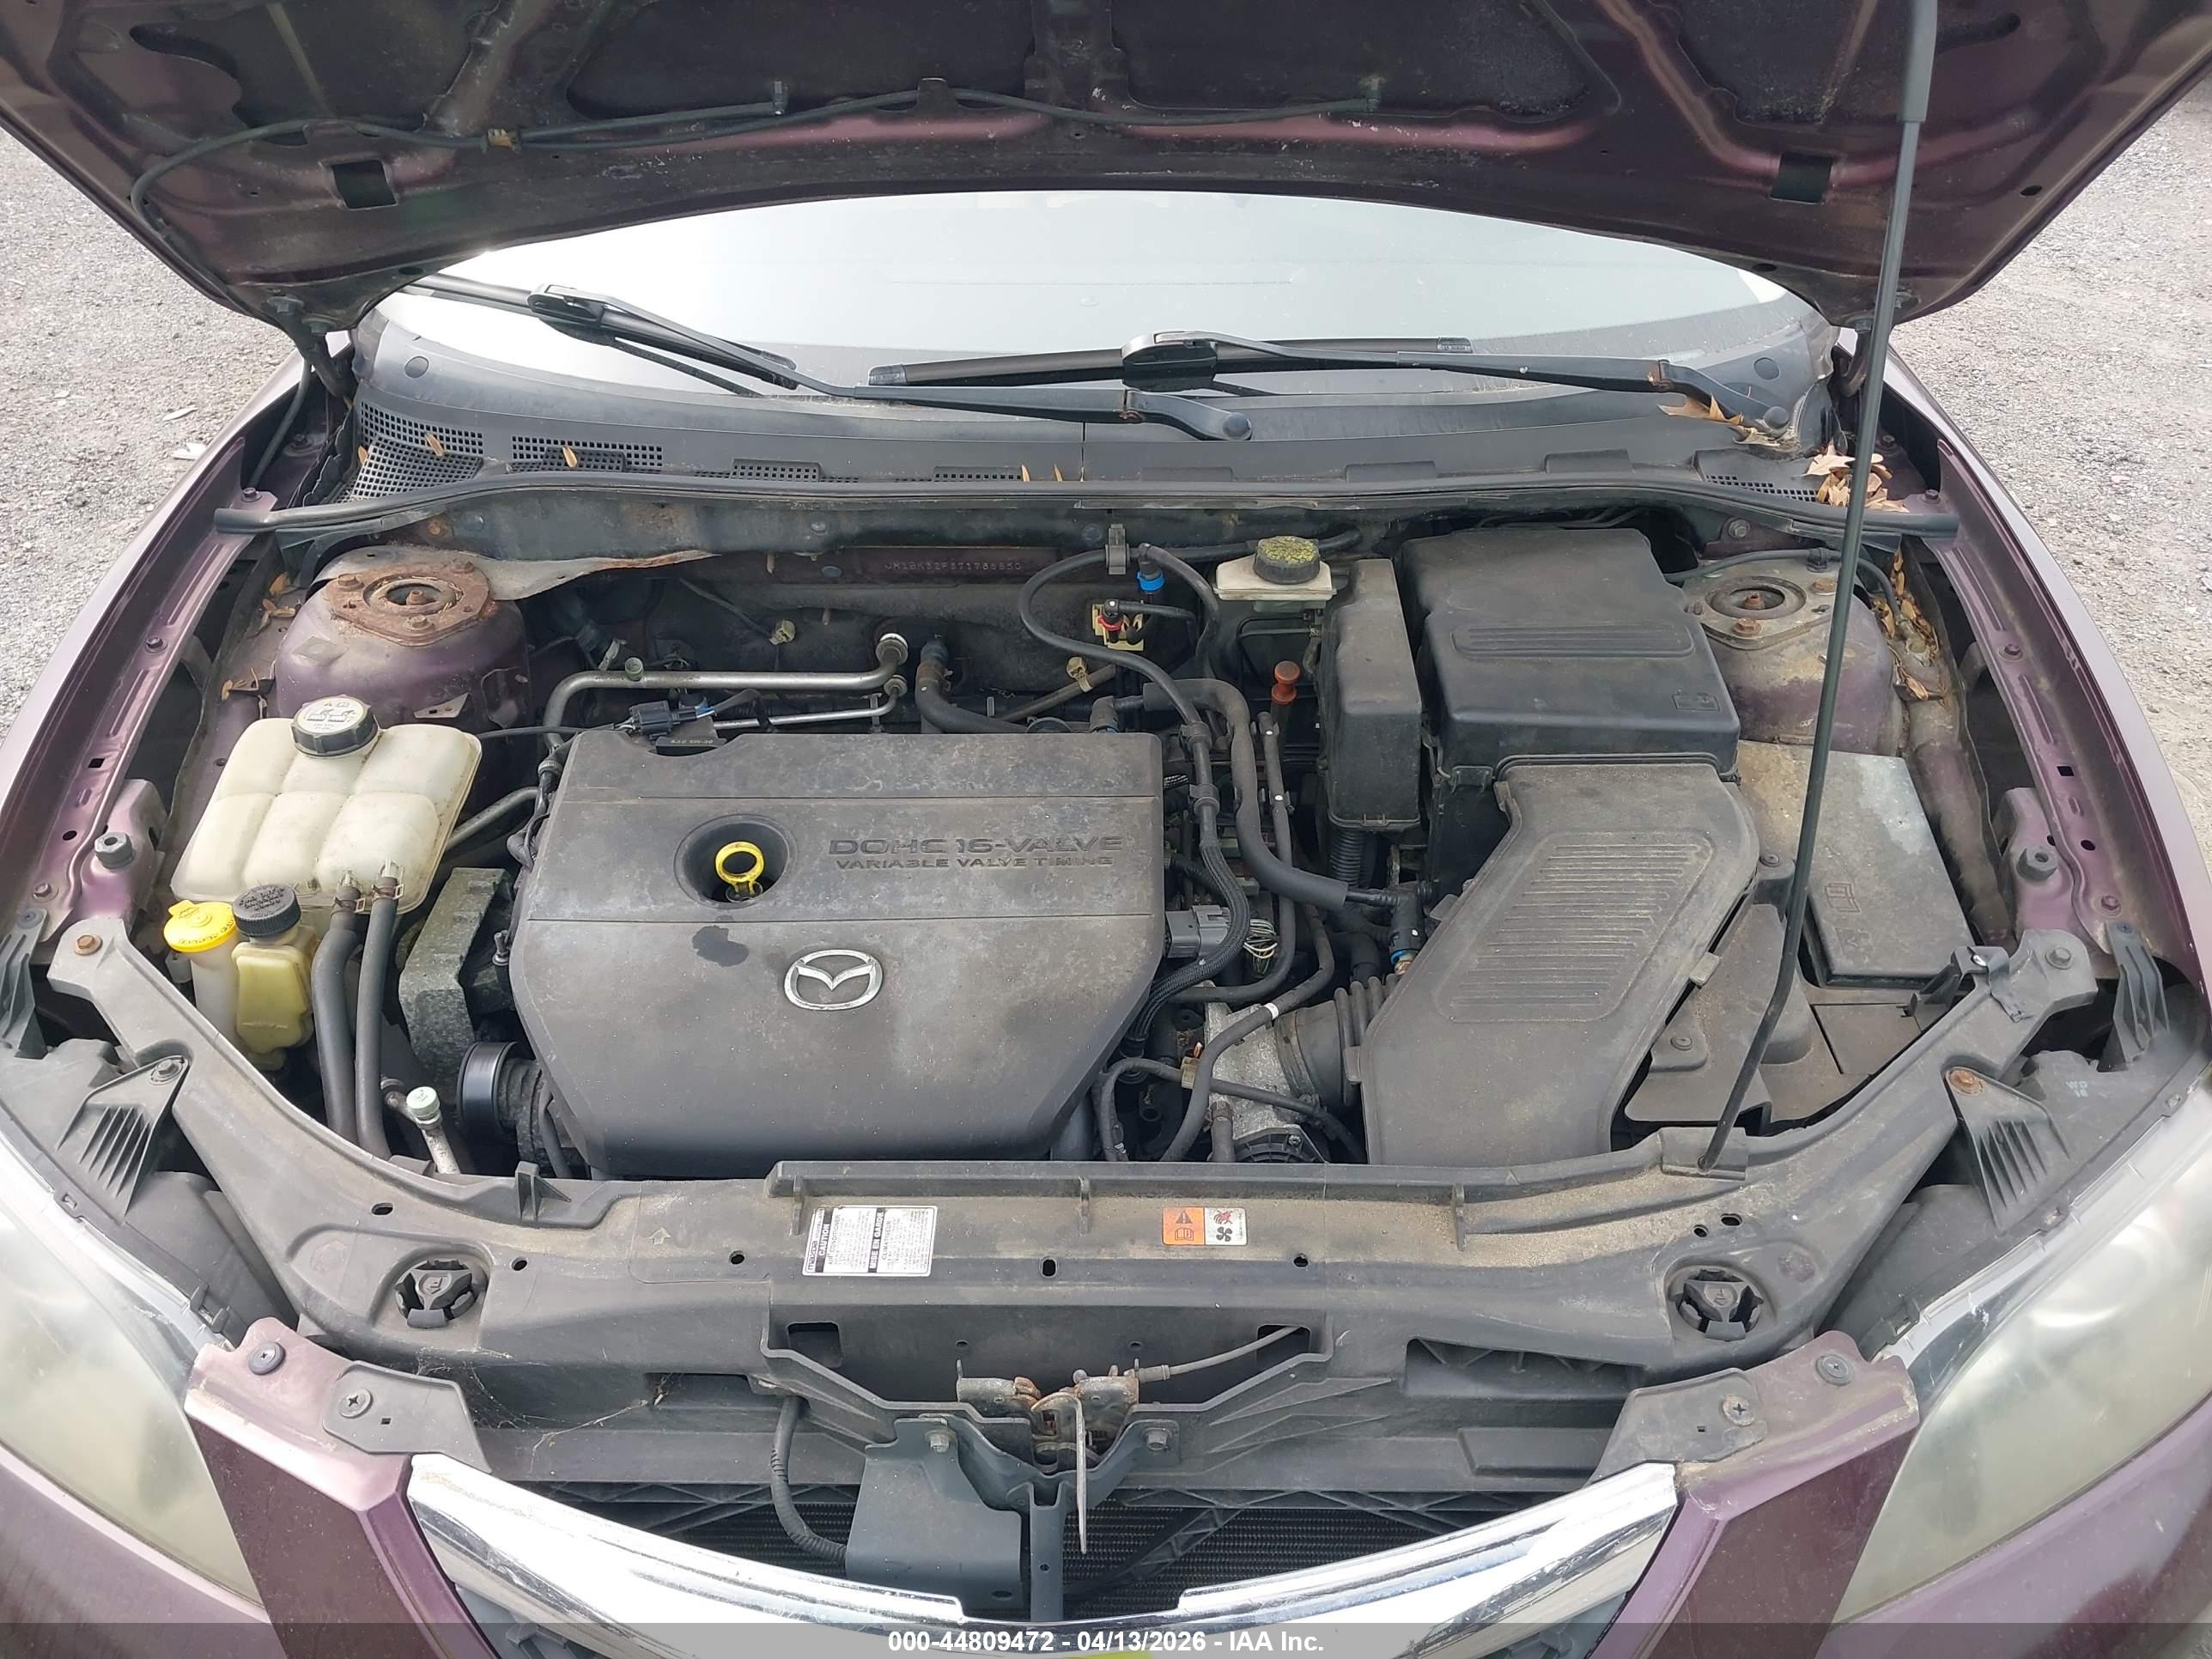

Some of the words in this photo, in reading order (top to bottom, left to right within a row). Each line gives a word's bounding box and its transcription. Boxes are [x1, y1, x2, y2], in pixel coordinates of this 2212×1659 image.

[829, 838, 946, 855] DOHC
[956, 836, 1121, 854] 16-VALVE
[836, 858, 950, 869] VARIABLE
[957, 857, 1028, 867] VALVE
[1034, 856, 1114, 866] TIMING
[830, 1214, 842, 1252] CONDITIONER
[874, 1212, 884, 1237] GARDE
[818, 1224, 830, 1255] CAUTION
[872, 1238, 880, 1249] EN
[869, 1249, 878, 1268] MISE
